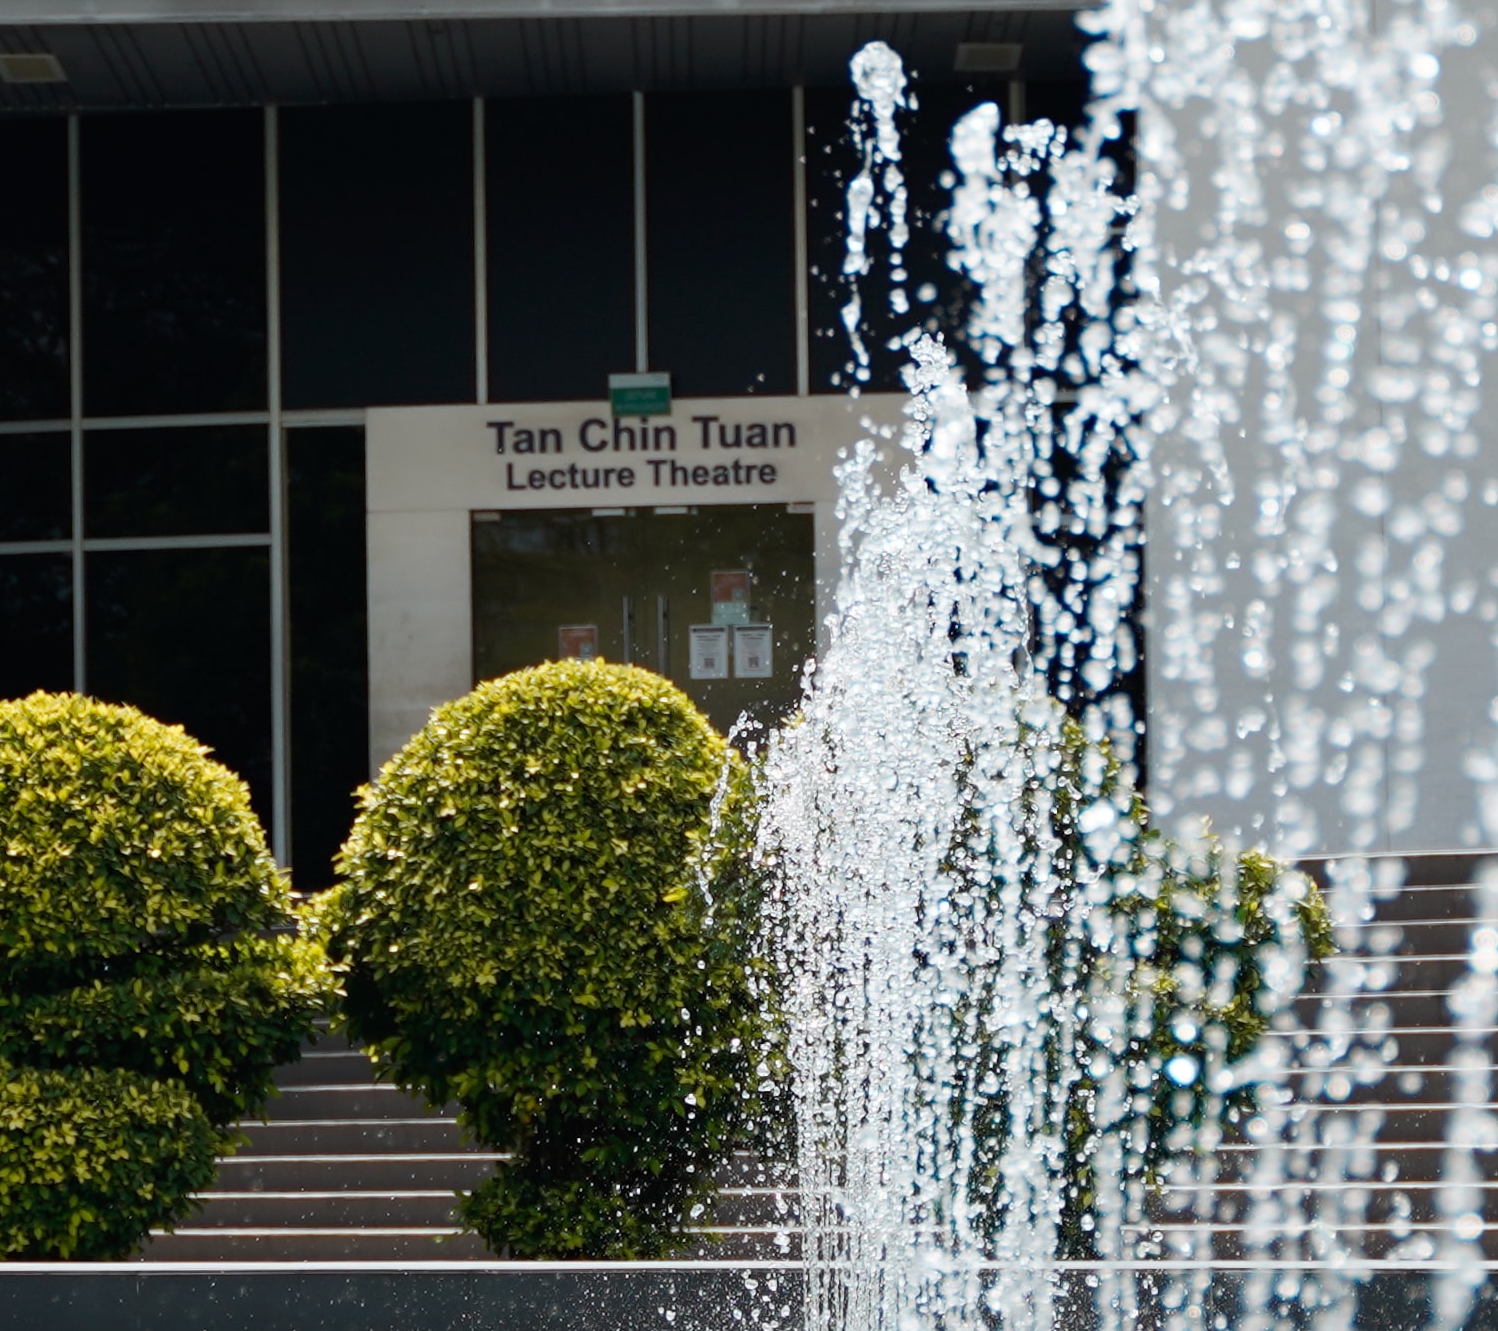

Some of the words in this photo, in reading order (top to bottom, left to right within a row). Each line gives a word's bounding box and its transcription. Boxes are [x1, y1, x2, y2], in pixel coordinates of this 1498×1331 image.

[485, 420, 564, 455] Tan
[577, 415, 677, 453] Chin
[690, 415, 797, 450] Tuan
[505, 462, 636, 491] Lecture
[645, 458, 778, 487] Theatre
